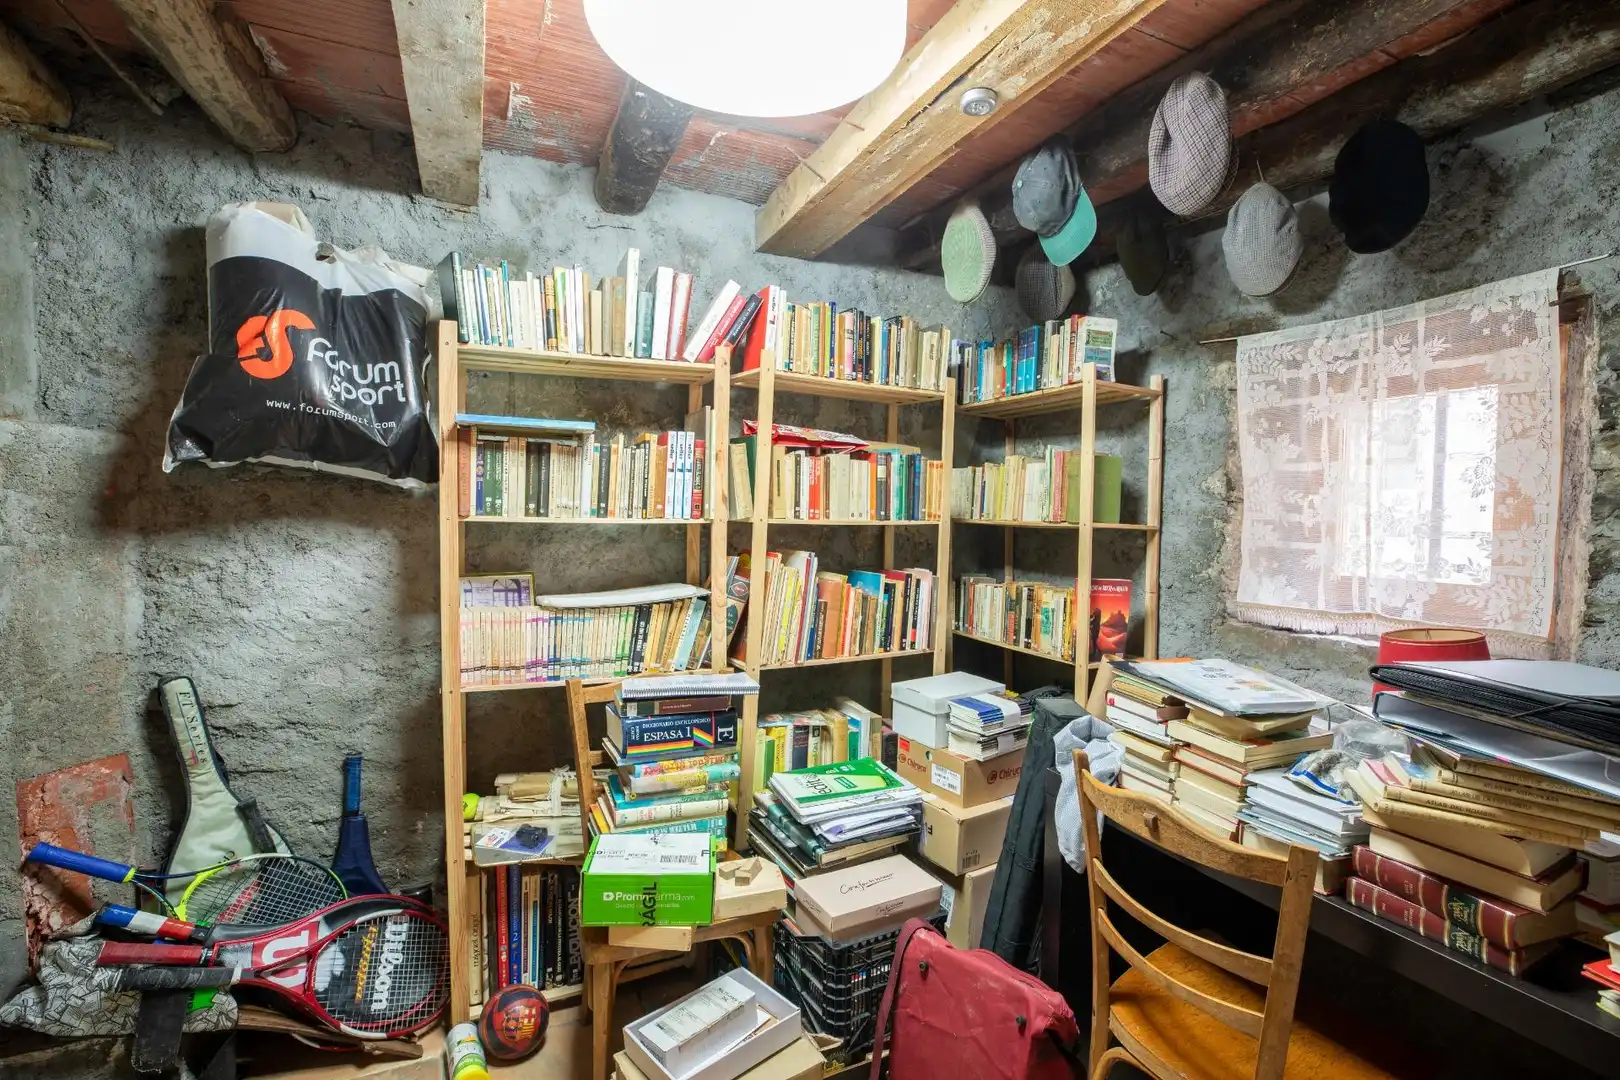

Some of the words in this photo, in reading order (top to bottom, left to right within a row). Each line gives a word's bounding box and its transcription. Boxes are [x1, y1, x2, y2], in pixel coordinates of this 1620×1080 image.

[187, 717, 209, 765] Series
[643, 730, 685, 742] ESPASA
[717, 725, 734, 742] E
[998, 766, 1021, 780] Chiruc
[371, 922, 409, 1012] Wilson
